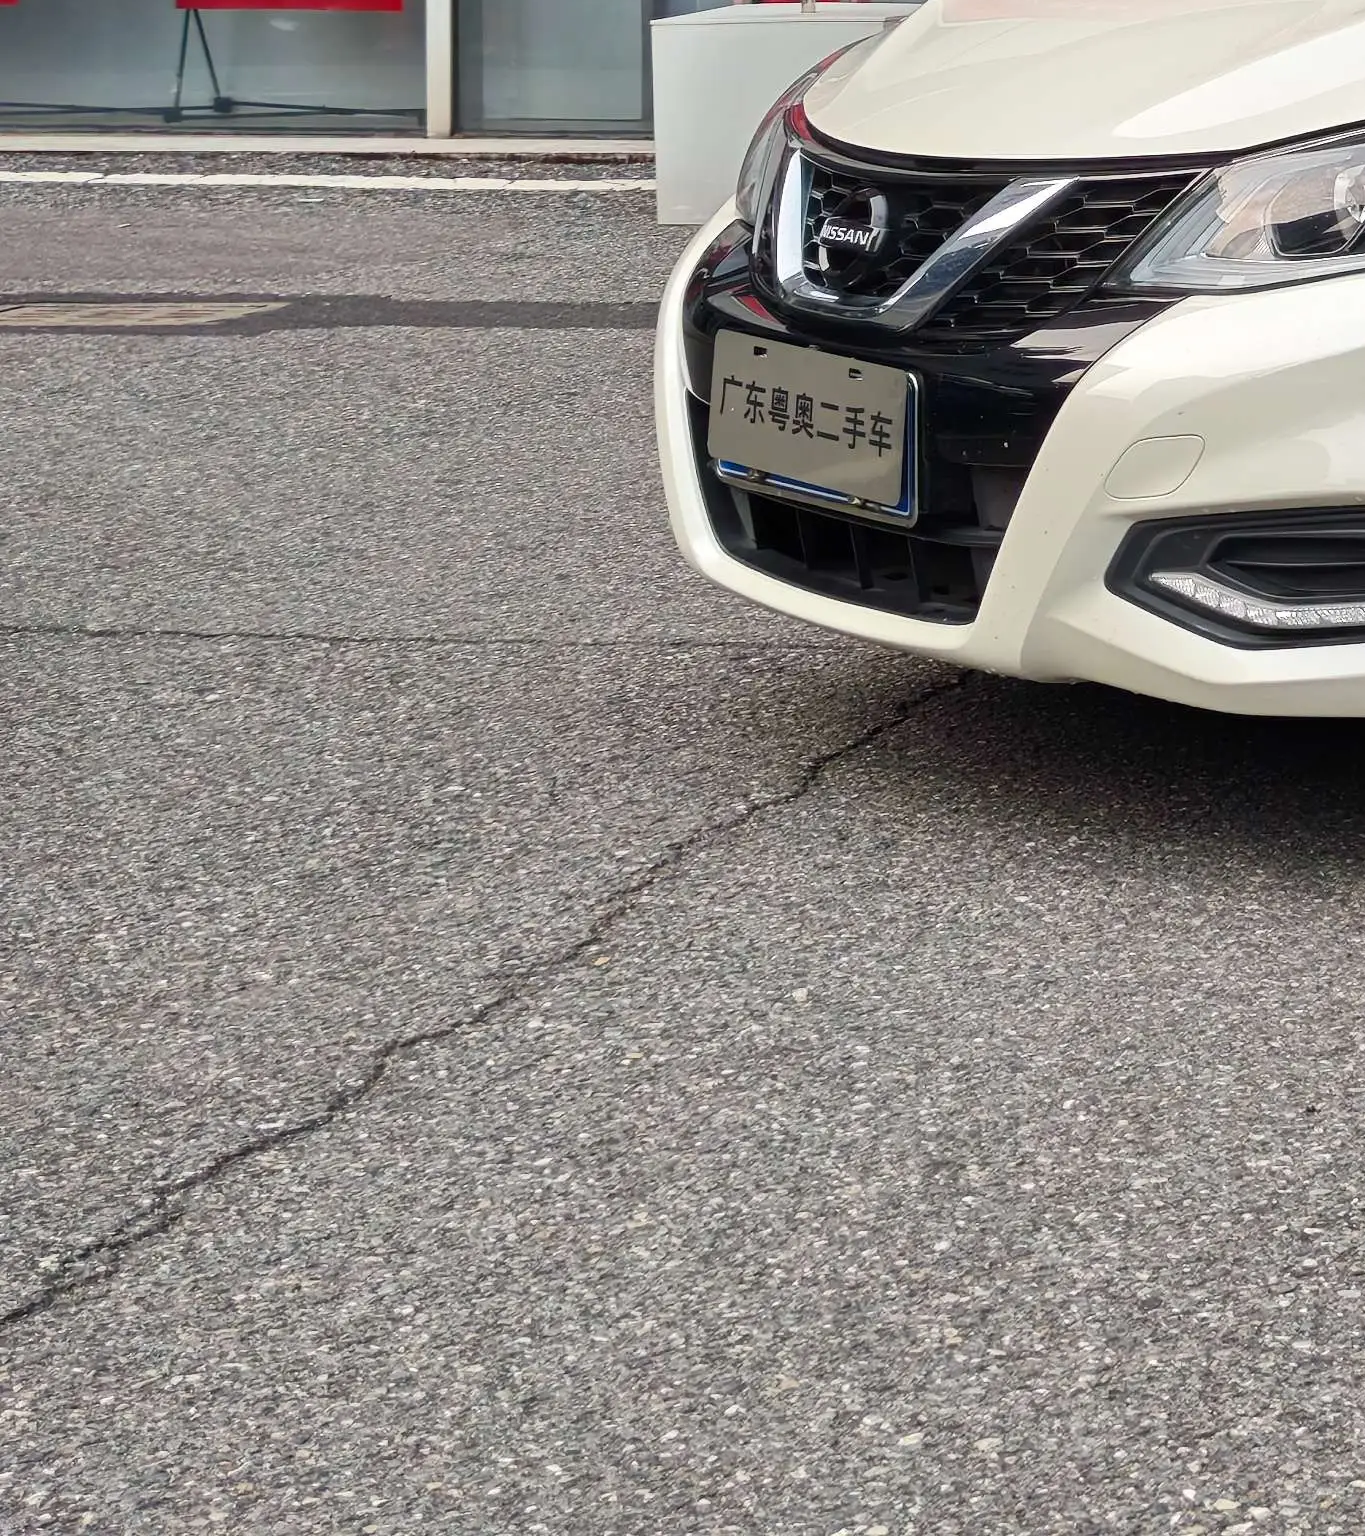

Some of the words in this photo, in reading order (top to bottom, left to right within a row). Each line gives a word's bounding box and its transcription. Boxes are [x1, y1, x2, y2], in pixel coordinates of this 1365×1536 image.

[822, 224, 870, 246] NISSAN
[719, 374, 895, 458] 广东粤奥二手车
